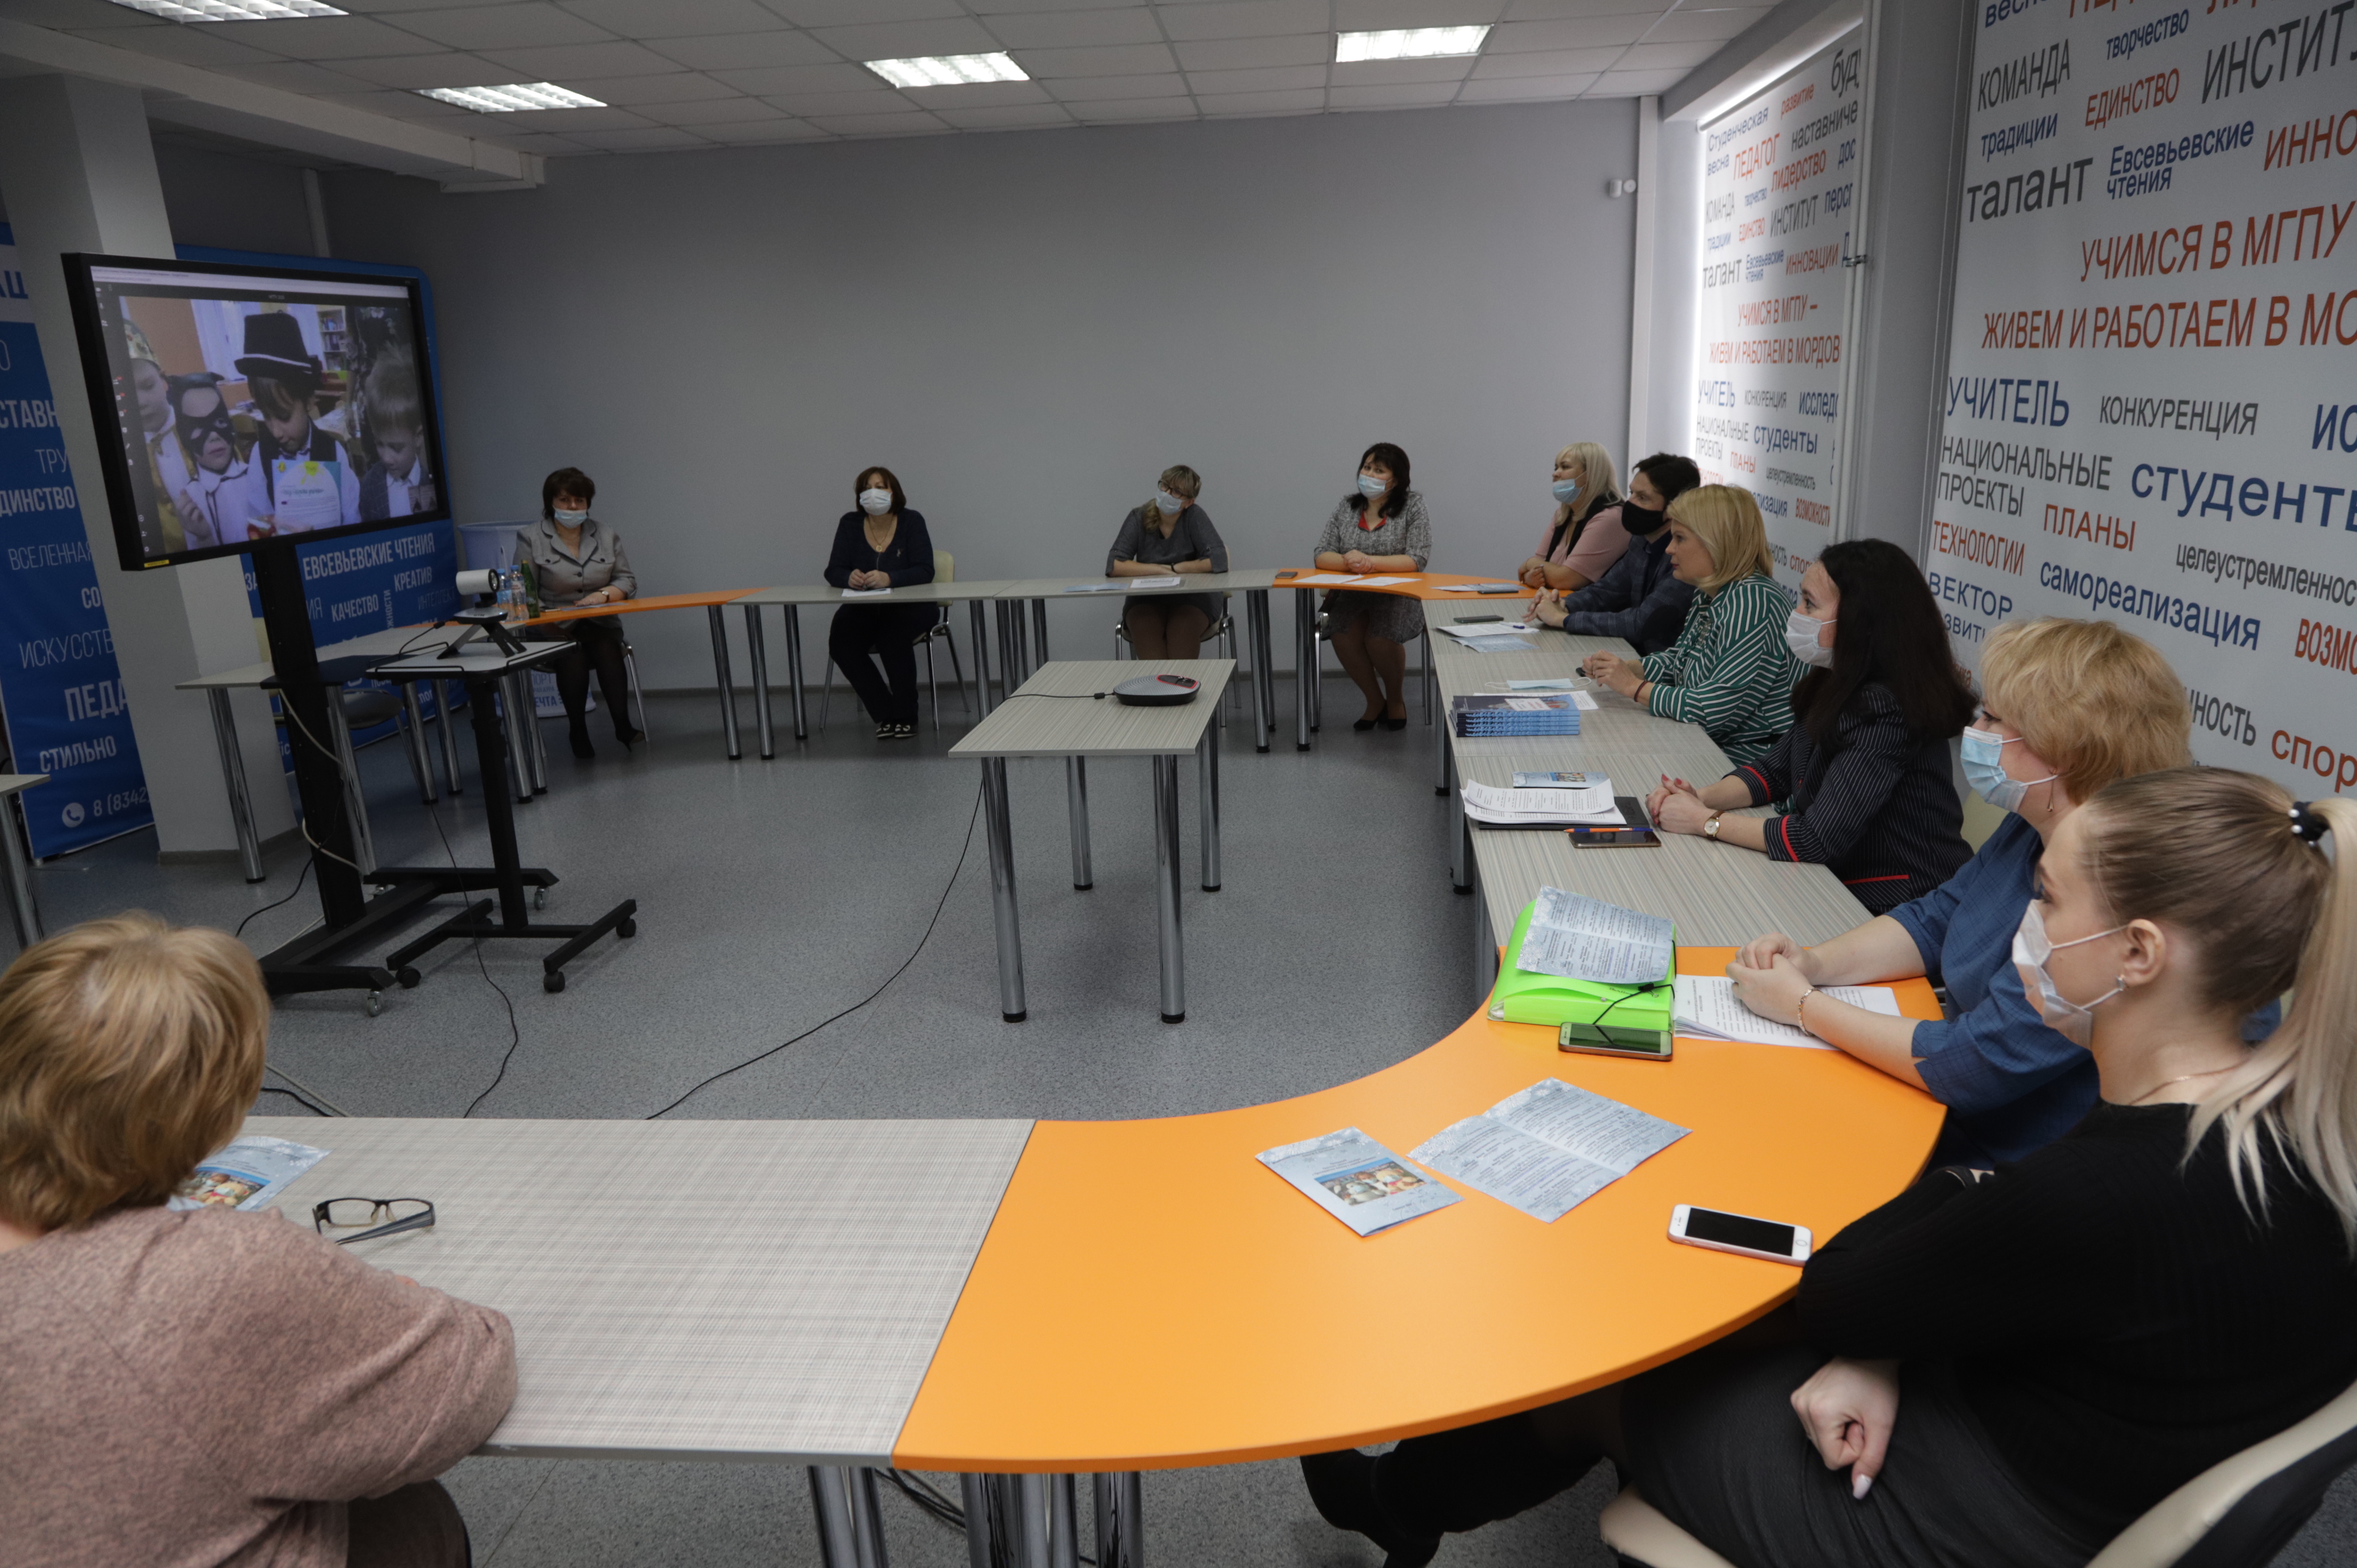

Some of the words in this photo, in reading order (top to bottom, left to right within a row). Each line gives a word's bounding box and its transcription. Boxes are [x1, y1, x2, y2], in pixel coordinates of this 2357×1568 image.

[2107, 9, 2189, 60] творчество
[2202, 0, 2357, 104] ИНСТИТ
[1831, 48, 1861, 97] буд
[1977, 39, 2070, 112] КОМАНДА
[1781, 83, 1814, 118] развитие
[2085, 68, 2179, 130] ЕДИНСТВО
[1708, 106, 1768, 152] Студенческая
[1981, 113, 2058, 162] традиции
[2109, 121, 2254, 176] Евсевьевские
[1708, 154, 1729, 176] весна
[1733, 133, 1780, 180] ПЕДАГОГ
[1771, 149, 1826, 193] лидерство
[1967, 157, 2094, 222] талант
[2107, 167, 2172, 200] чтения
[1705, 192, 1735, 224] КОМАНДА
[1739, 218, 1765, 242] ЕДИНСТВО
[1771, 195, 1818, 237] ИНСТИТУТ
[1786, 244, 1839, 276] ИННОВАЦИИ
[2081, 224, 2203, 282] УЧИМСЯ
[2210, 221, 2232, 269] В
[2242, 201, 2357, 267] МГПУ
[1703, 259, 1742, 289] талант
[1746, 265, 1764, 282] чтения
[1738, 300, 1771, 327] УЧИМСЯ
[1773, 300, 1779, 324] В
[1781, 295, 1809, 323] МГПУ
[1981, 309, 2063, 348] ЖИВЕМ
[2069, 308, 2087, 348] И
[2092, 298, 2257, 348] РАБОТАЕМ
[2264, 296, 2290, 346] В
[1709, 340, 1733, 363] ЖИВЕМ
[1734, 339, 1741, 363] И
[1742, 338, 1785, 363] РАБОТАЕМ
[1788, 337, 1793, 363] В
[1795, 335, 1840, 368] МОРДОВ
[1698, 379, 1735, 408] УЧИТЕЛЬ
[1745, 390, 1787, 410] КОНКУРЕНЦИЯ
[1947, 377, 2070, 427] УЧИТЕЛЬ
[1697, 415, 1749, 442] НАЦИОНАЛЬНЫЕ
[1754, 424, 1818, 454] студенты
[2099, 395, 2258, 440] КОНКУРЕНЦИЯ
[1696, 437, 1723, 461] ПРОЕКТЫ
[1730, 451, 1755, 474] ПЛАНЫ
[1942, 436, 2112, 491] НАЦИОНАЛЬНЫЕ
[1938, 472, 2024, 517] ПРОЕКТЫ
[1933, 519, 2025, 576] ТЕХНОЛОГИИ
[2044, 504, 2135, 551] ПЛАНЫ
[303, 540, 394, 580] ЕВСЕВЬЕВСКИЕ
[395, 532, 435, 560] ЧТЕНИЯ
[394, 566, 432, 592] КРЕАТИВ
[1929, 572, 2013, 620] ВЕКТОР
[331, 594, 379, 622] КАЧЕСТВО
[2040, 561, 2261, 650] самореализация
[40, 735, 117, 773] СТИЛЬНО
[93, 799, 103, 817] 8
